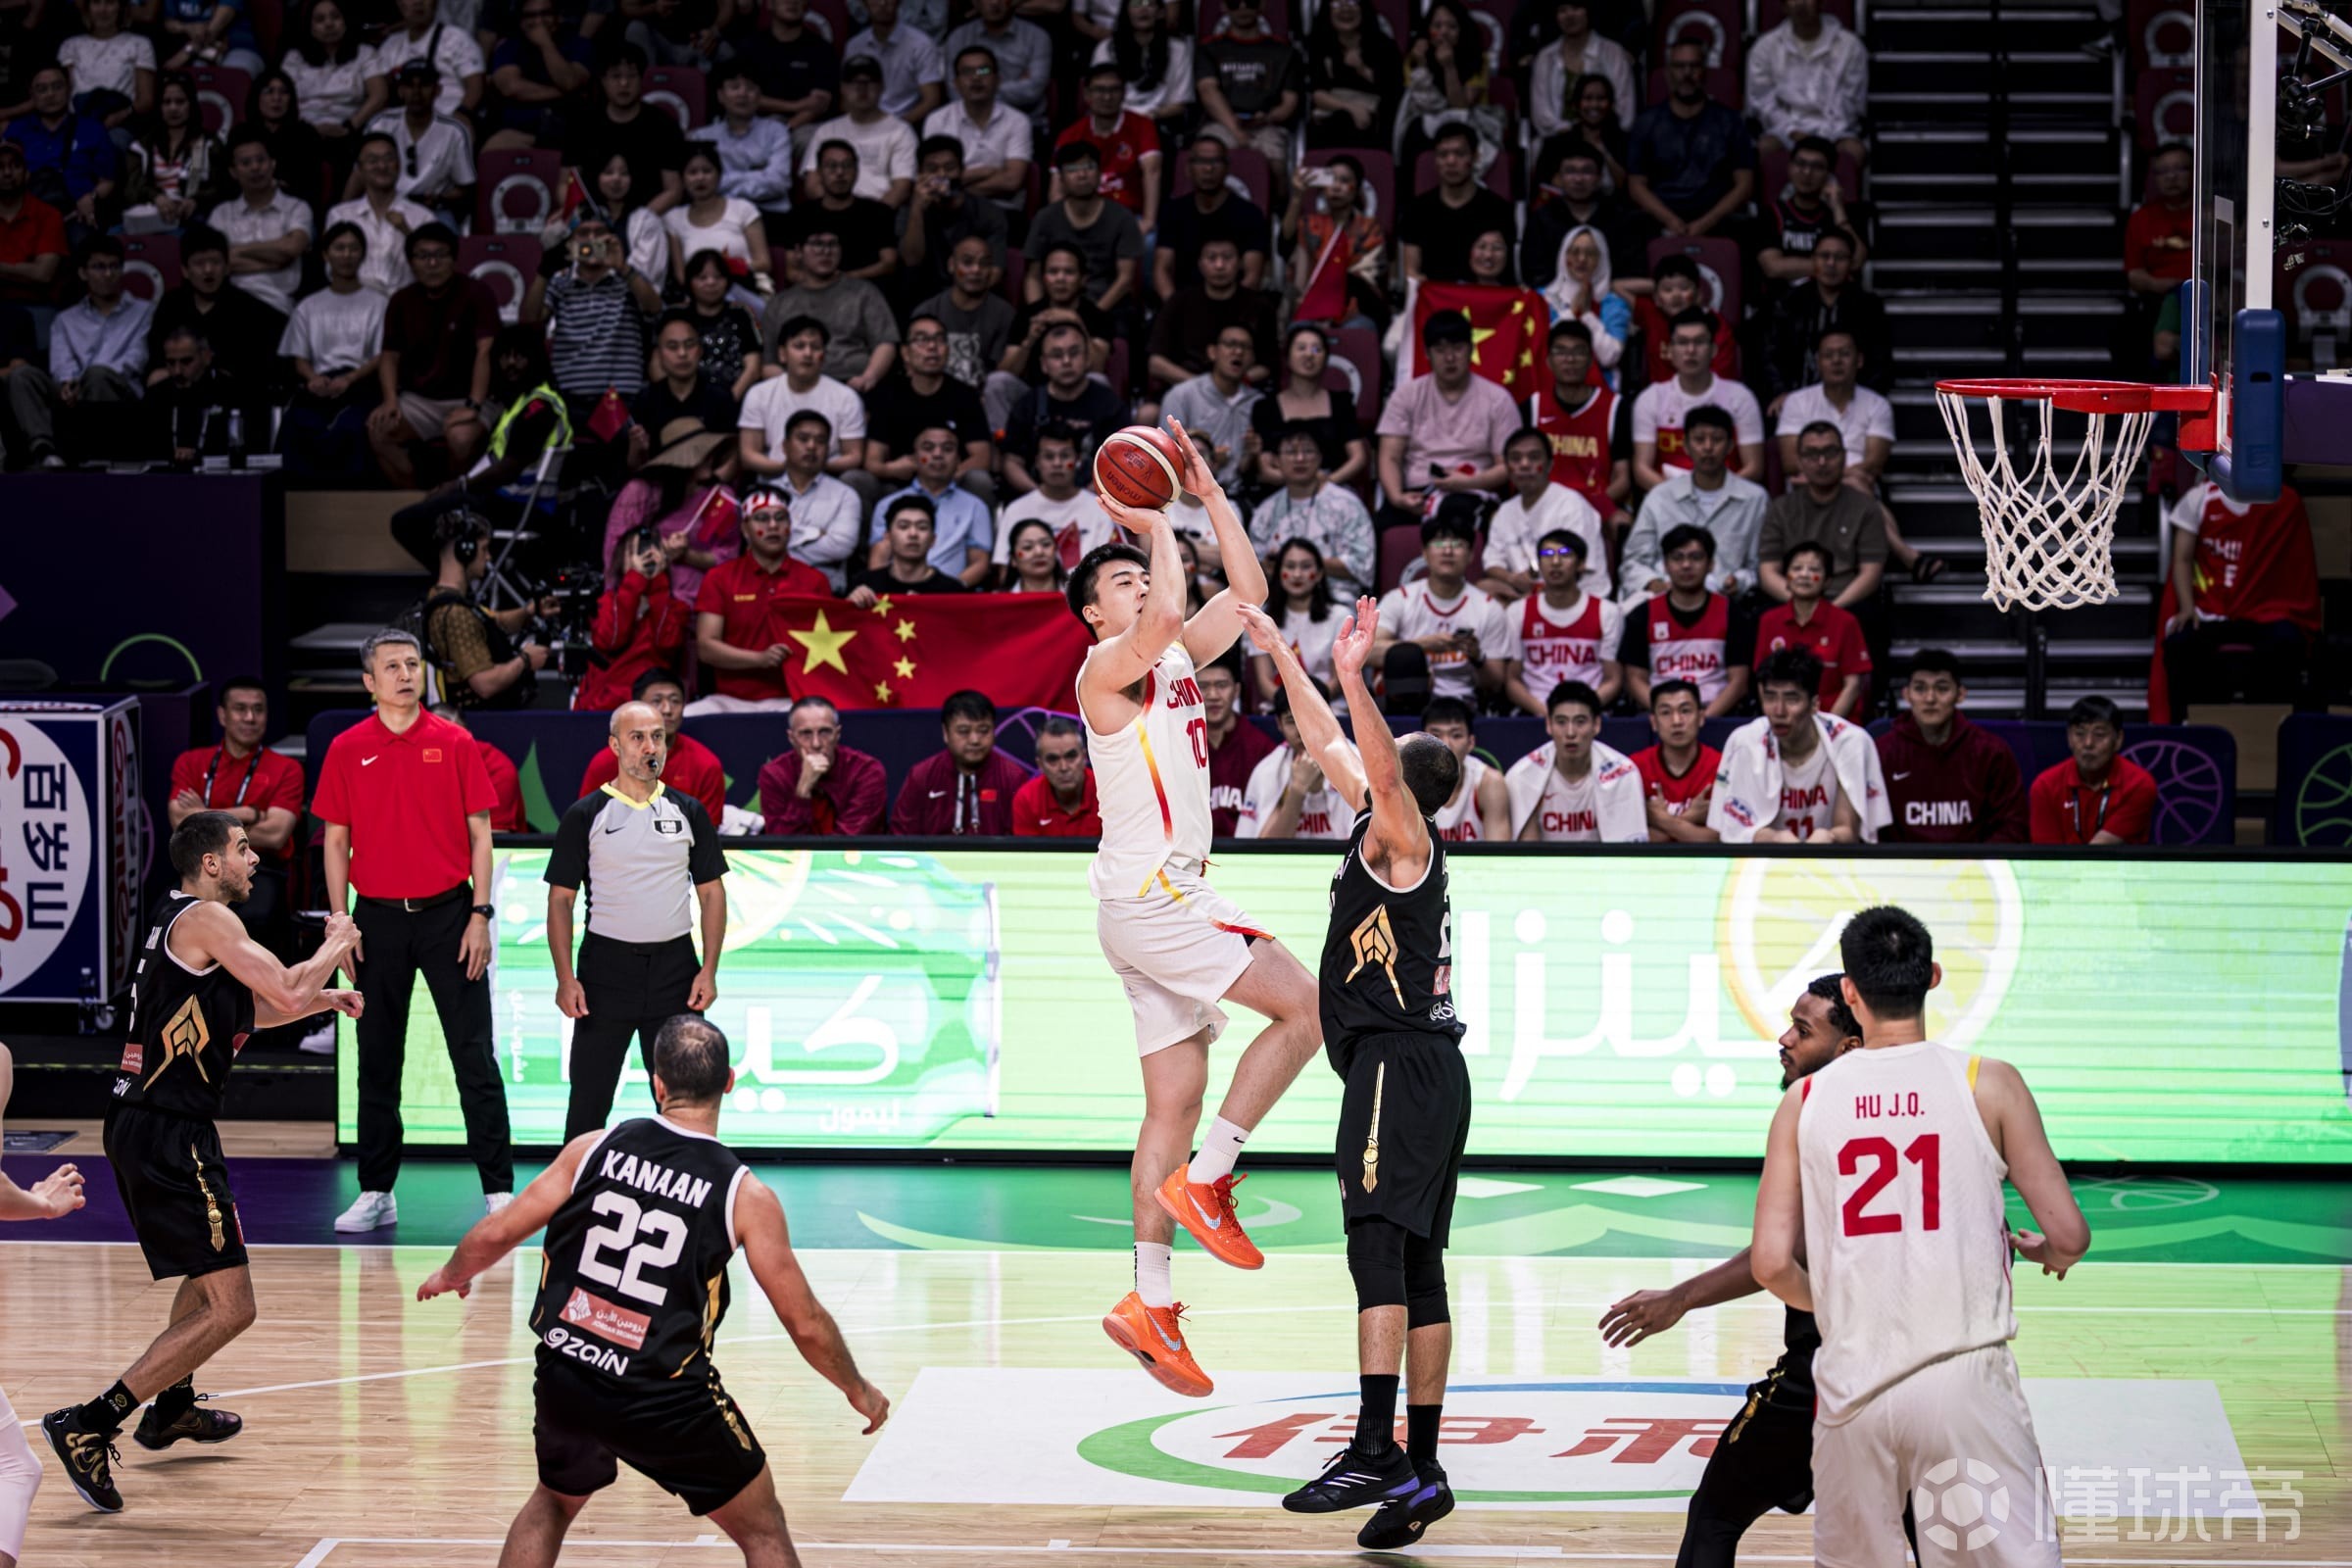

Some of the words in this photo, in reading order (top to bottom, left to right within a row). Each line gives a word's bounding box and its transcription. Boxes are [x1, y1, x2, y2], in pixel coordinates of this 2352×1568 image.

[1526, 644, 1596, 666] CHINA
[1656, 653, 1719, 674] CHINA
[1167, 676, 1204, 710] CHIN
[1186, 717, 1207, 769] 10
[1780, 784, 1829, 809] HINA
[1905, 800, 1973, 825] CHINA
[23, 762, 69, 930] 百岁山
[1856, 1094, 1881, 1119] HU
[1887, 1092, 1926, 1117] J.Q.
[600, 1149, 712, 1208] KANAAN
[1838, 1133, 1940, 1237] 21
[577, 1190, 689, 1306] 22
